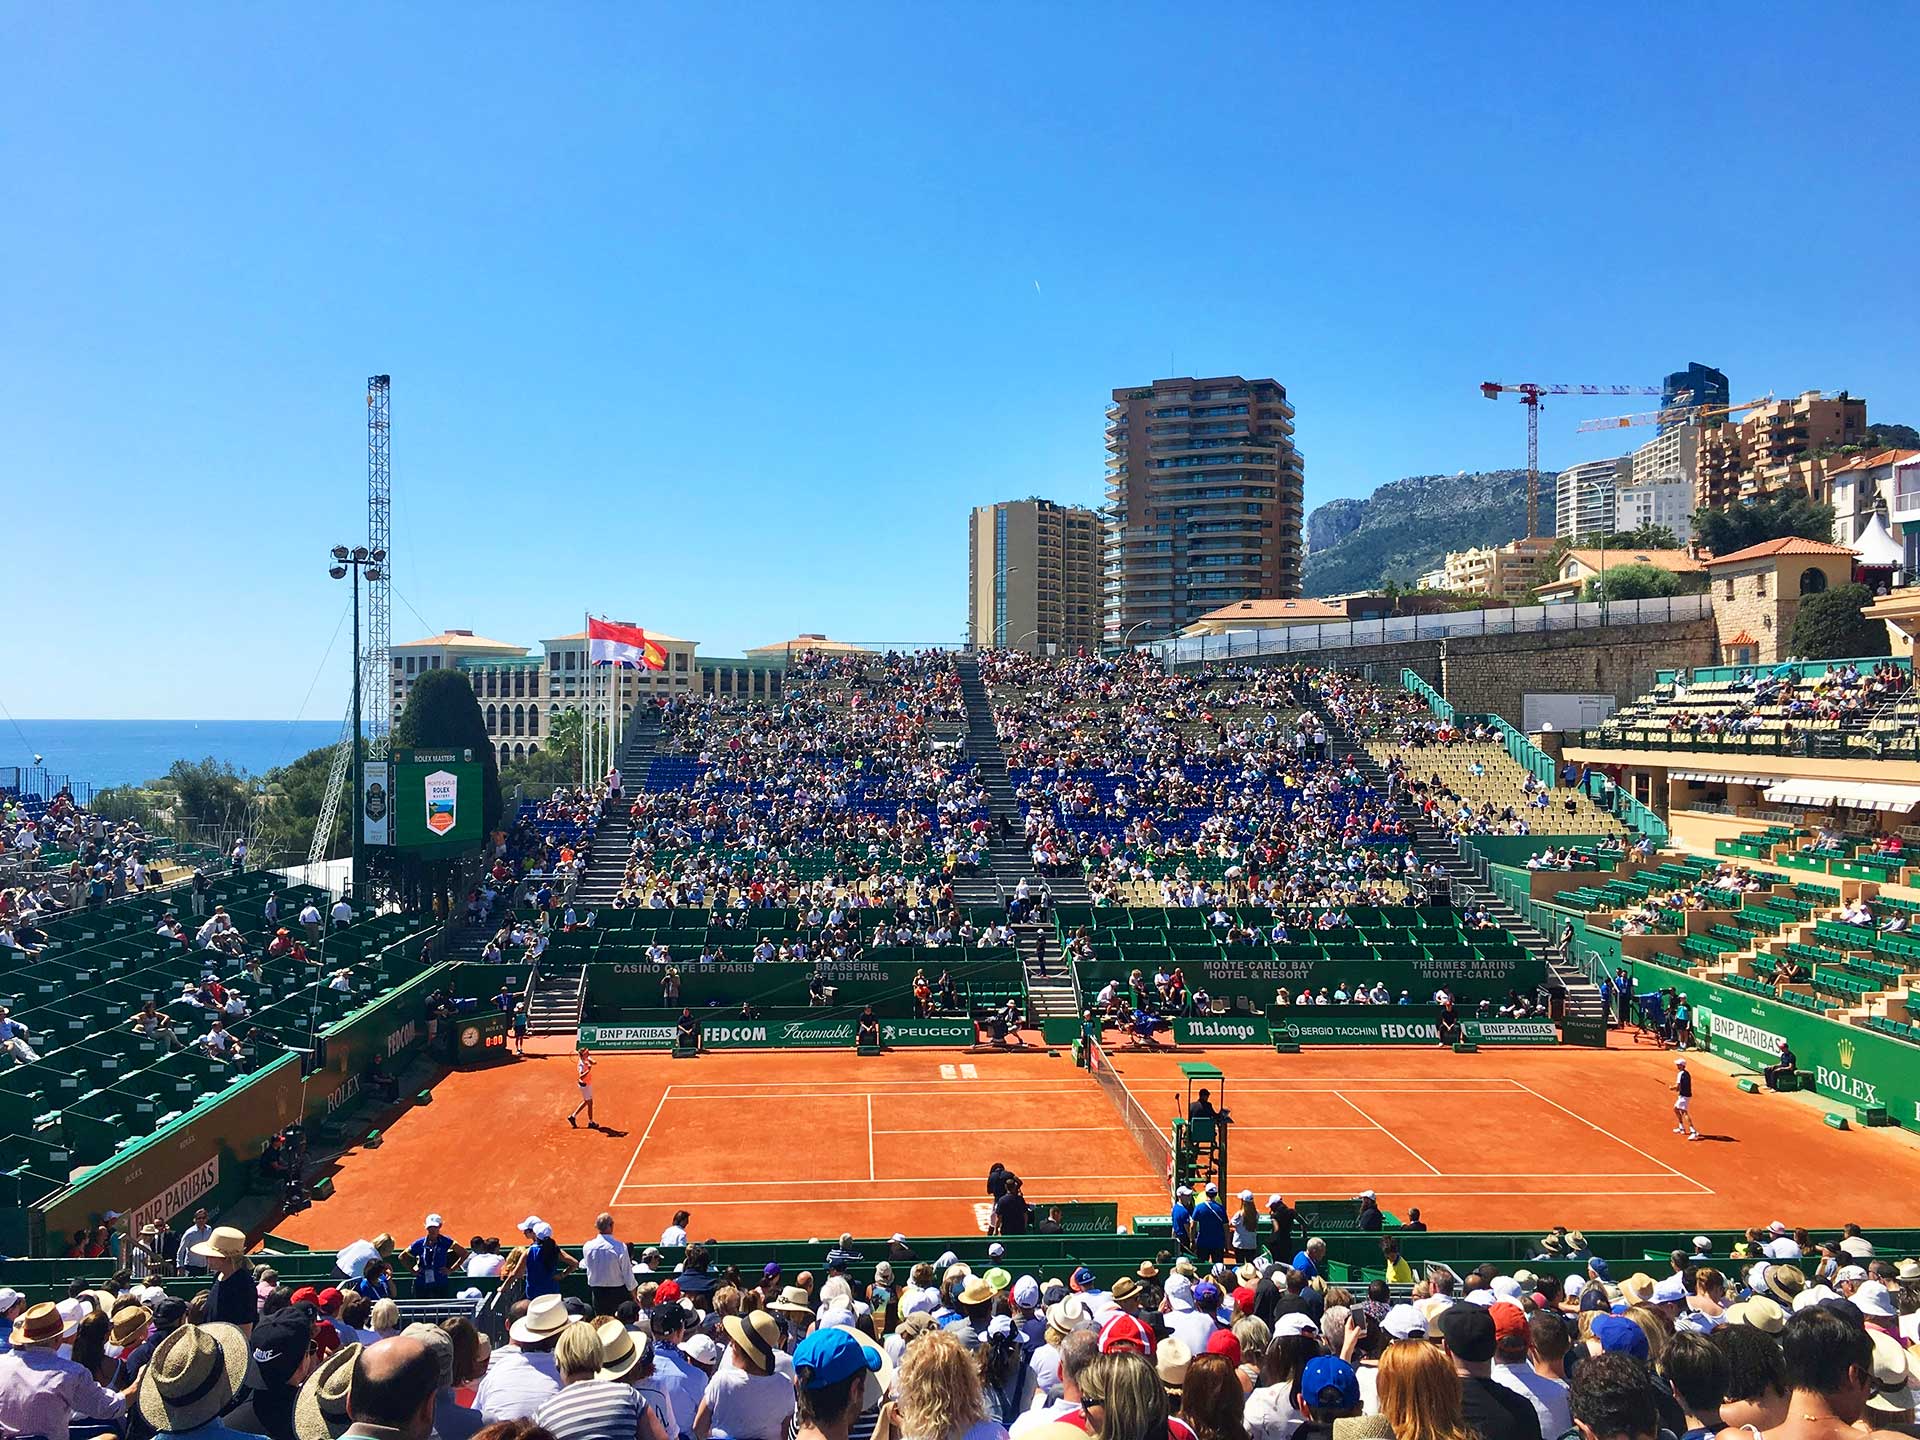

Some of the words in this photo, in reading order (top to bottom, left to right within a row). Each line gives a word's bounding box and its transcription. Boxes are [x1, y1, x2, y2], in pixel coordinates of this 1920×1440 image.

[613, 964, 660, 974] CASINO
[700, 964, 716, 973] DE
[719, 963, 756, 973] PARIS
[815, 962, 879, 972] BRASSERIE
[1203, 961, 1287, 970] MONTE-CARLO
[1291, 961, 1315, 970] BAY
[1412, 961, 1467, 970] THERMES
[1472, 961, 1516, 970] MARINS
[838, 972, 853, 981] DE
[856, 972, 889, 981] PARIS
[1209, 970, 1247, 979] HOTEL
[1250, 970, 1260, 979] &
[1263, 970, 1310, 979] RESORT
[1422, 970, 1506, 979] MONTE-CARLO
[599, 1029, 623, 1039] BNP
[625, 1028, 672, 1039] PARIBAS
[703, 1026, 767, 1042] FEDCOM
[778, 1022, 854, 1040] Façonnable
[898, 1027, 972, 1037] PEUGEOT
[1188, 1021, 1255, 1041] Malongo
[1301, 1026, 1333, 1036] SERGIO
[1336, 1026, 1378, 1036] TACCHINI
[1380, 1024, 1440, 1039] FEDCOM
[1483, 1024, 1504, 1034] BNP
[1507, 1024, 1553, 1034] PARIBAS
[387, 1019, 415, 1058] FEDCOM
[485, 1034, 503, 1047] 0:00
[1714, 1017, 1735, 1036] BNP
[1736, 1025, 1782, 1054] PARIBAS
[1816, 1065, 1876, 1104] ROLEX
[328, 1073, 360, 1114] ROLEX
[135, 1198, 162, 1239] BNP
[165, 1161, 215, 1218] PARIBAS
